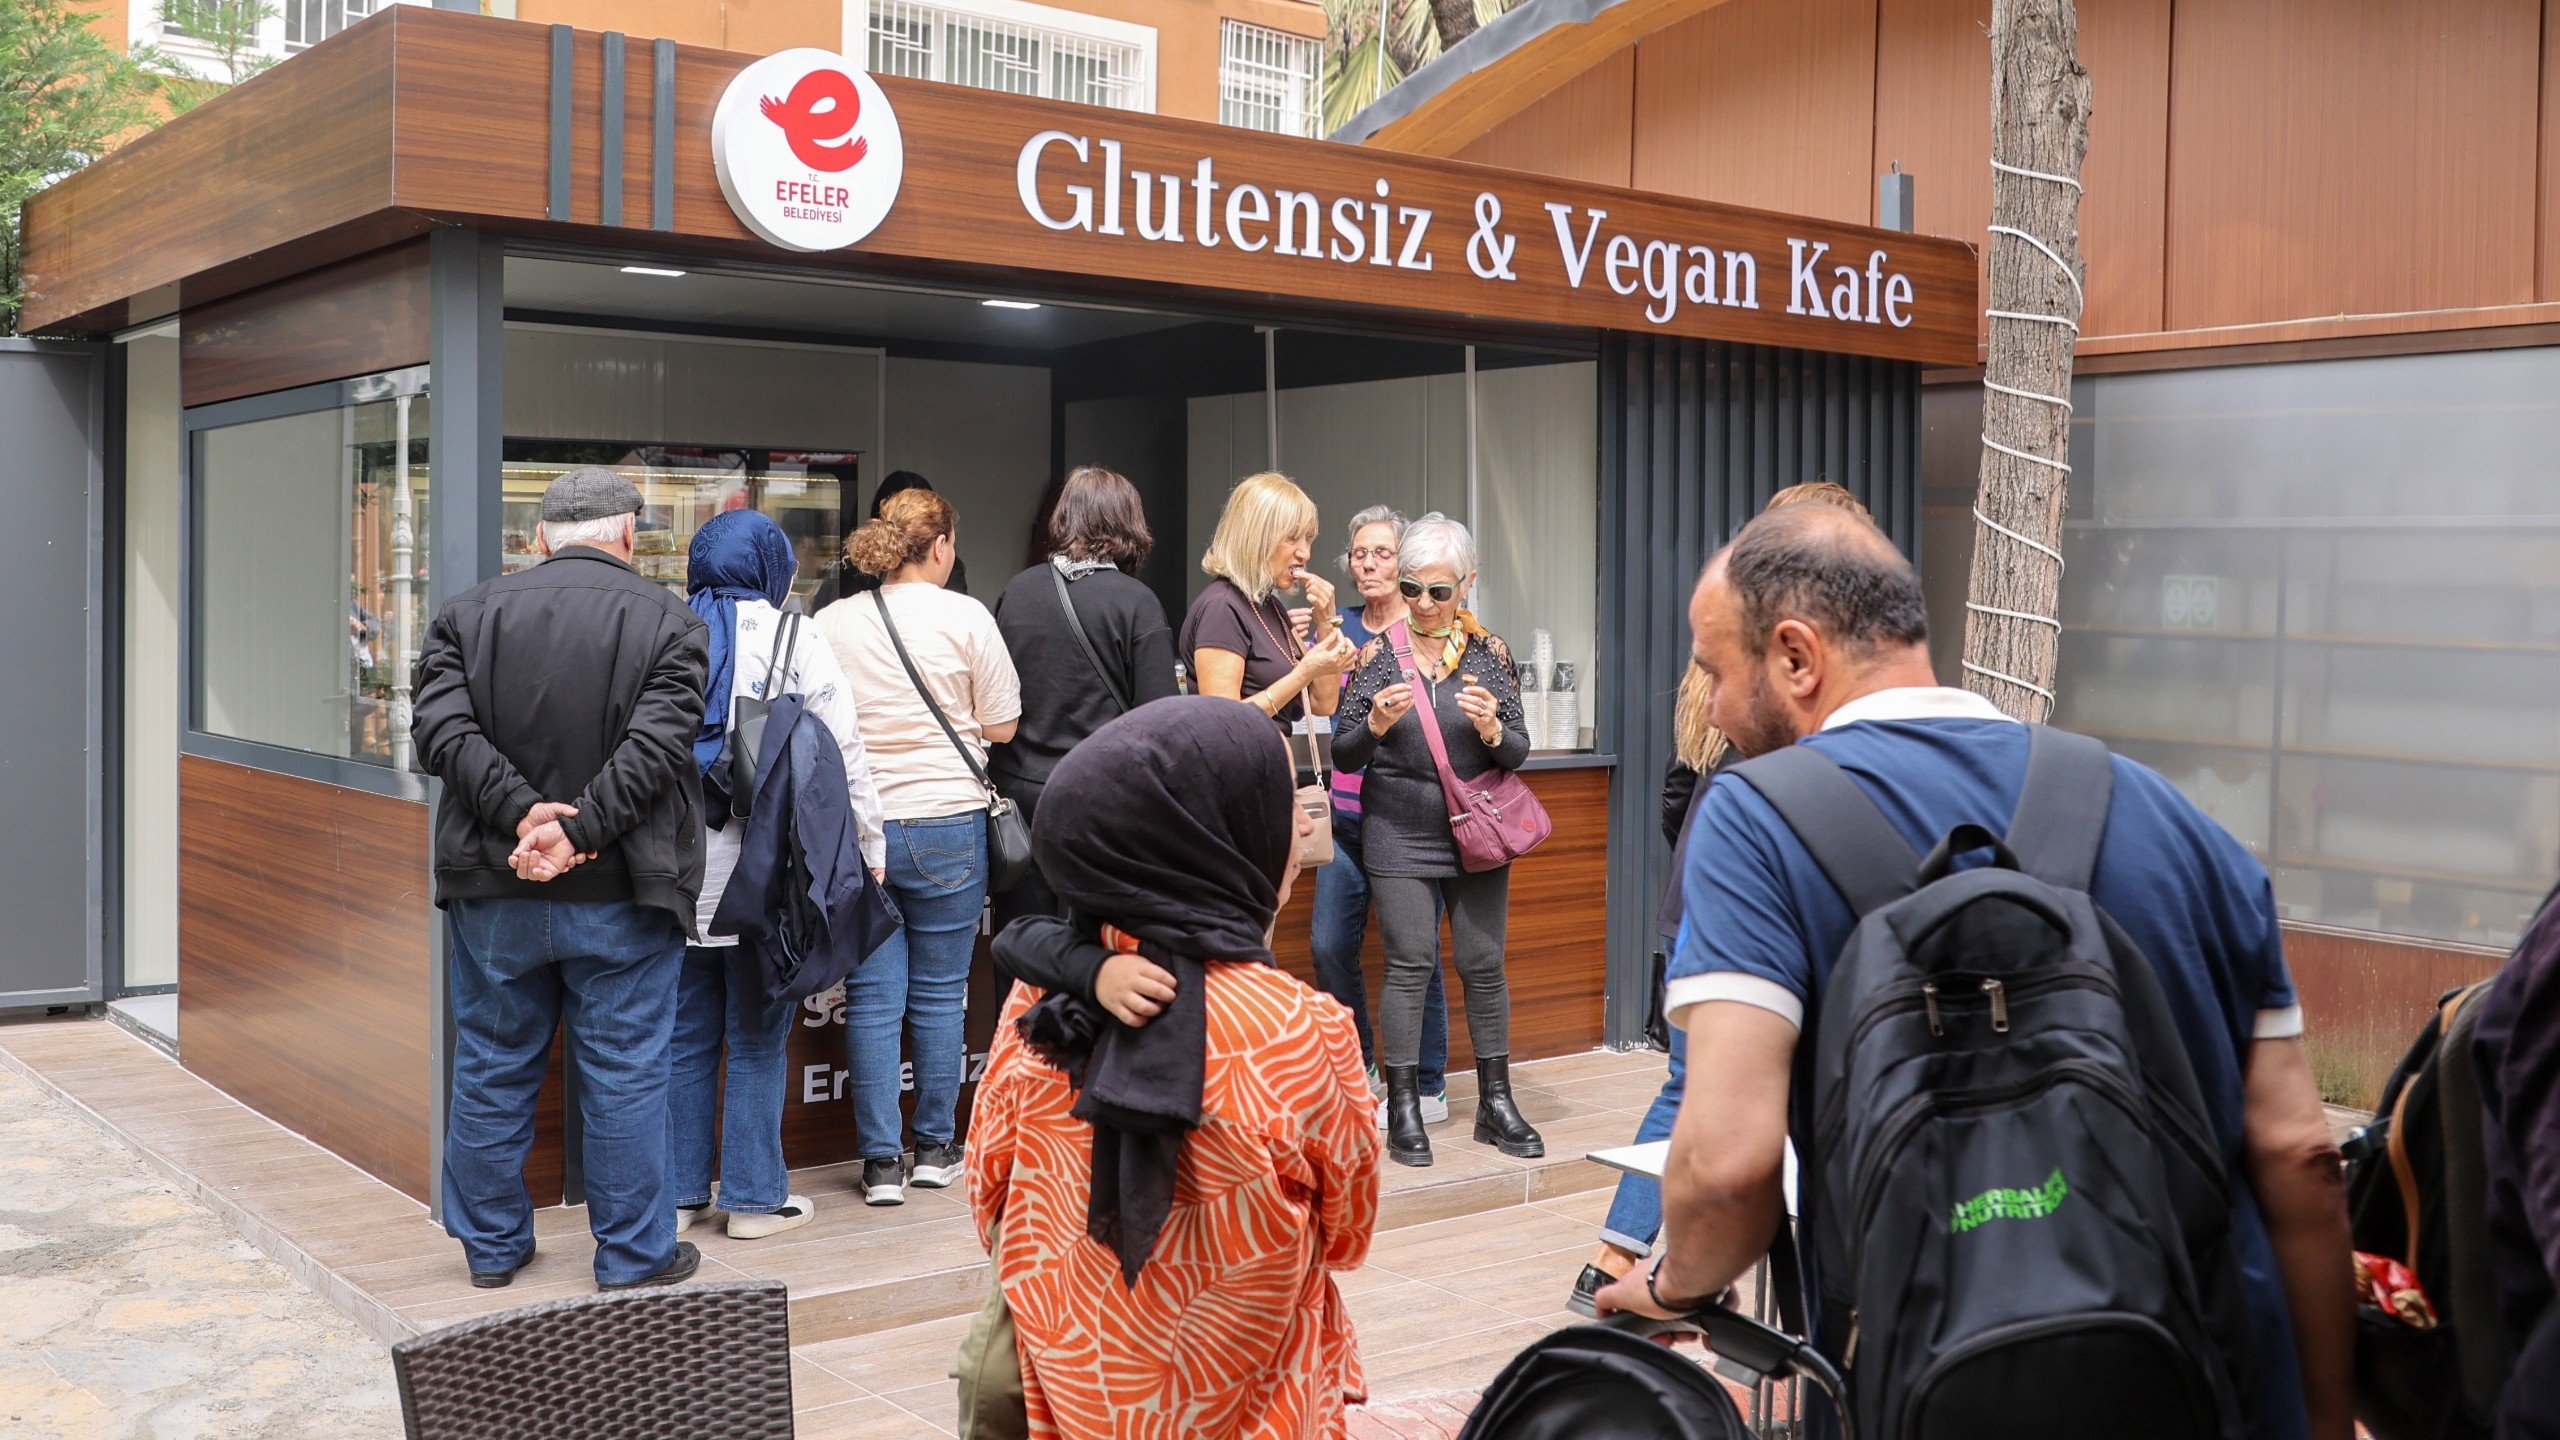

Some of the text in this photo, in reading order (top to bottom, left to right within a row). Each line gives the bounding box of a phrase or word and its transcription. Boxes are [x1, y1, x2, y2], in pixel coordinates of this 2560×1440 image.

[776, 180, 849, 209] EFELER
[783, 206, 842, 223] BELEDİYESİ
[1016, 130, 1913, 328] Glutensiz & Vegan Kafe
